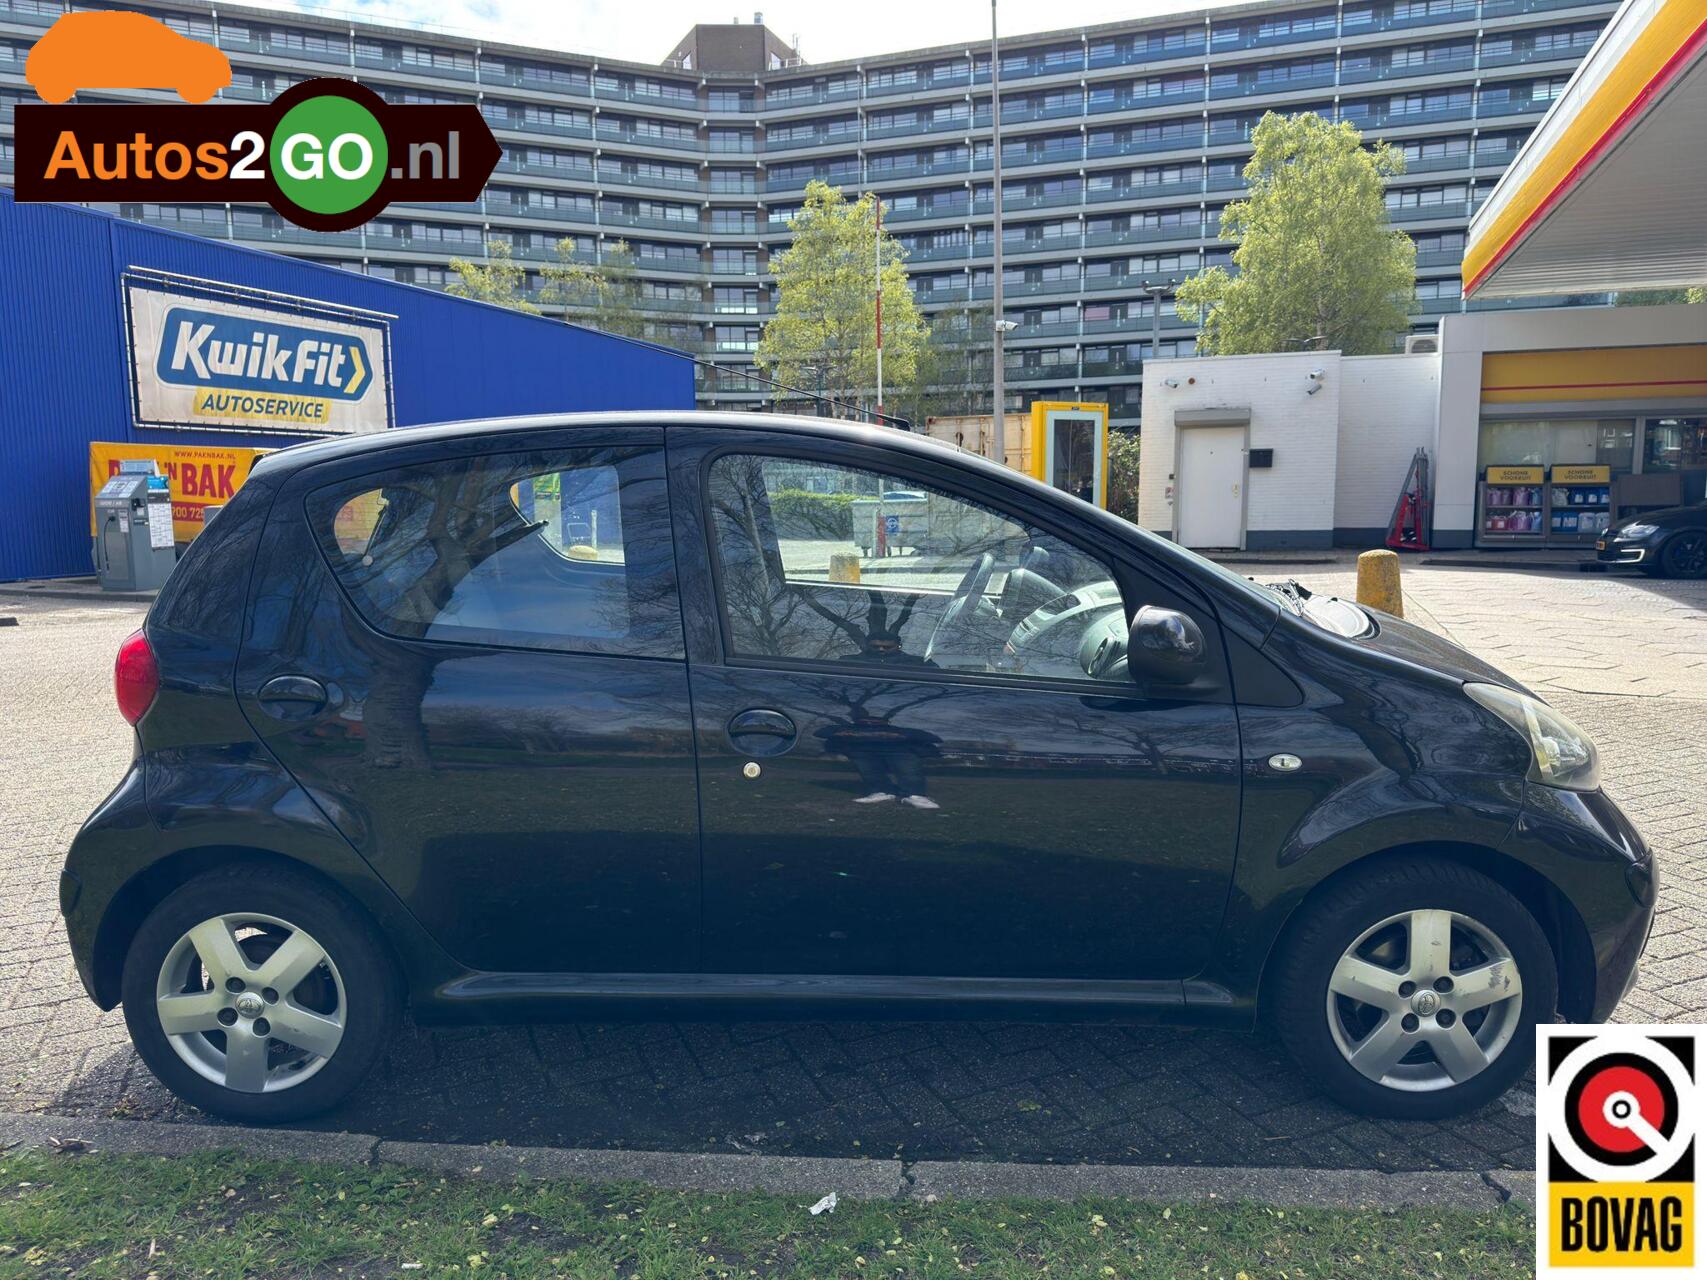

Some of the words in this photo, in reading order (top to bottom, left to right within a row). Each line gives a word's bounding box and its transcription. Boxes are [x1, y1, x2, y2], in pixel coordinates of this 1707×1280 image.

[201, 394, 324, 419] AUTOSERVICE
[175, 451, 236, 460] WWW.PAKNBAK.NL
[181, 463, 236, 499] BAK
